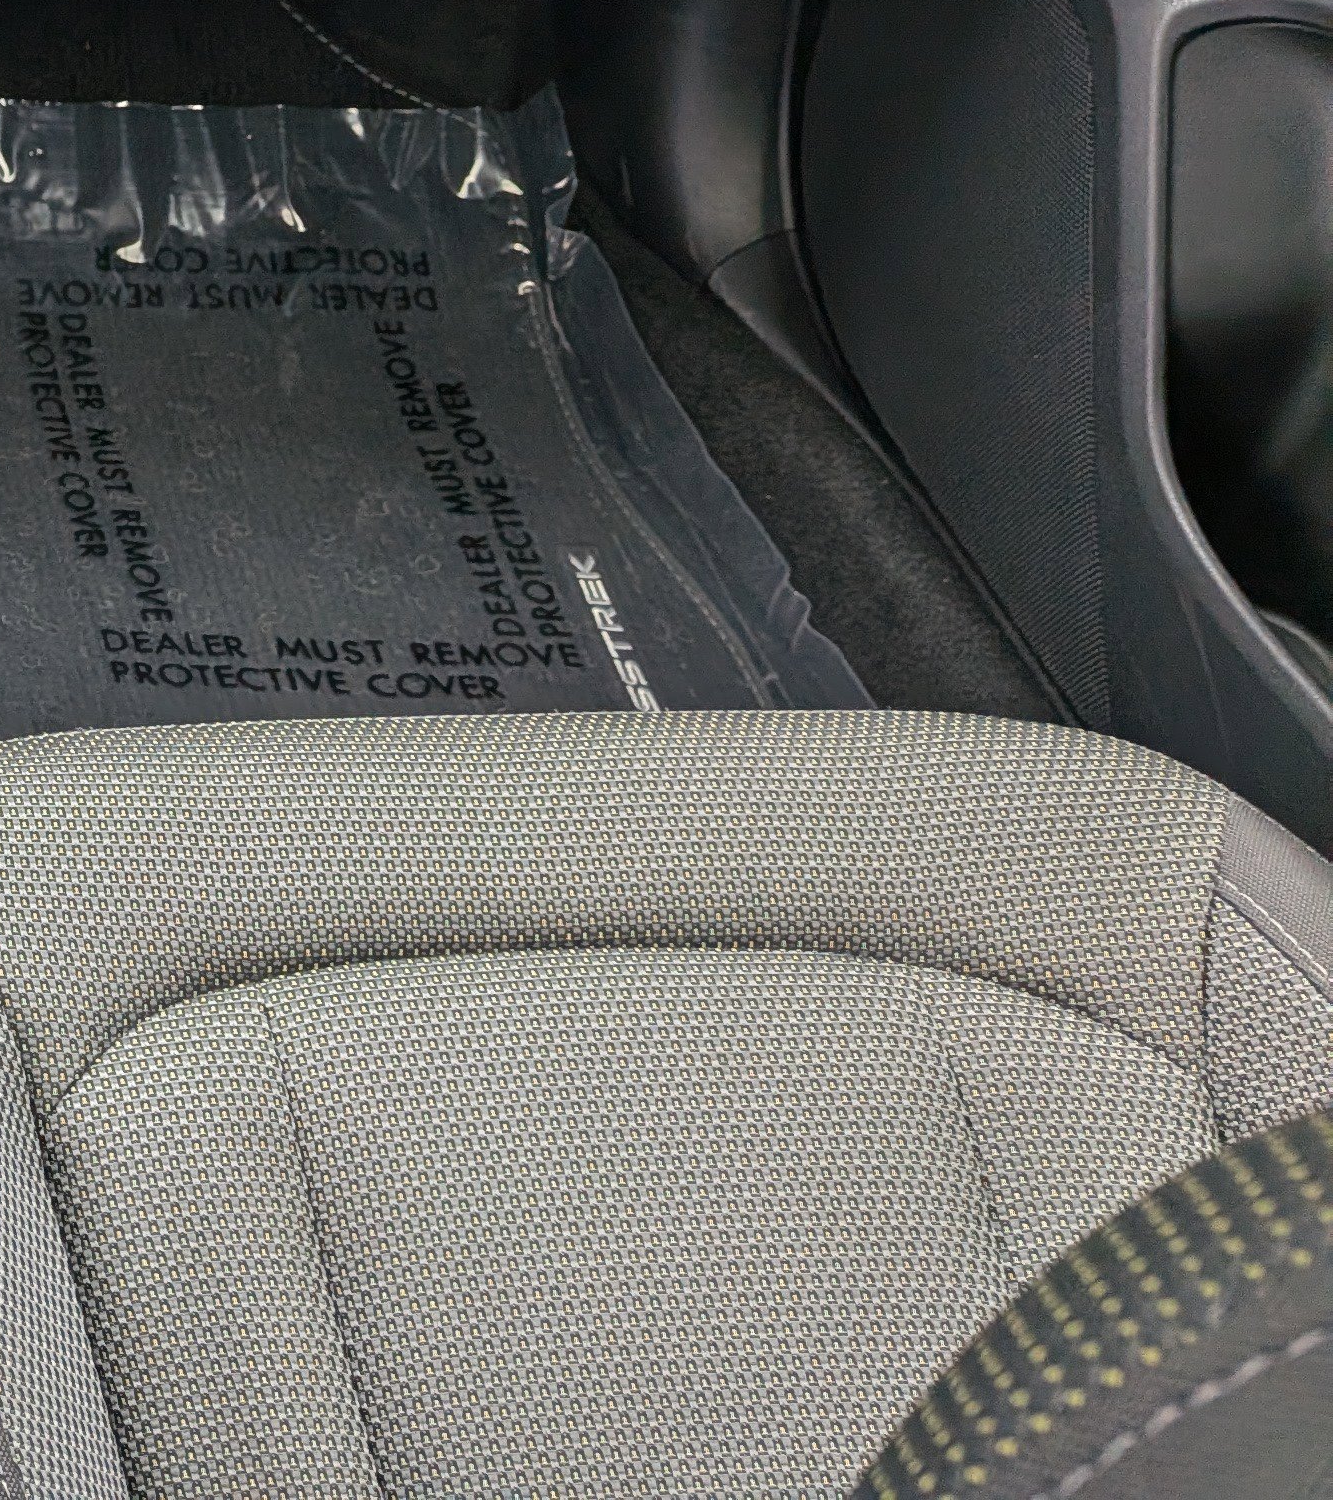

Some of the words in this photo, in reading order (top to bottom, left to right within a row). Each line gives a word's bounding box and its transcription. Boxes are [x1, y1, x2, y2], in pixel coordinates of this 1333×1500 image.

[186, 282, 290, 311] MUST
[374, 319, 438, 433] REMOVE
[436, 380, 495, 467] COVER
[17, 311, 81, 462] PROTECTIVE
[59, 472, 109, 560] COVER
[58, 313, 105, 410] DEALER
[86, 426, 133, 497] MUST
[112, 509, 174, 623] REMOVE
[418, 444, 476, 517] MUST
[457, 534, 527, 638] DEALER
[476, 475, 572, 638] PROTECTIVE
[100, 628, 247, 659] DEALER
[274, 636, 385, 666] MUST
[409, 641, 585, 669] REMOVE
[109, 659, 349, 696] PROTECTIVE
[367, 672, 507, 701] COVER
[567, 551, 661, 713] SSTREK
